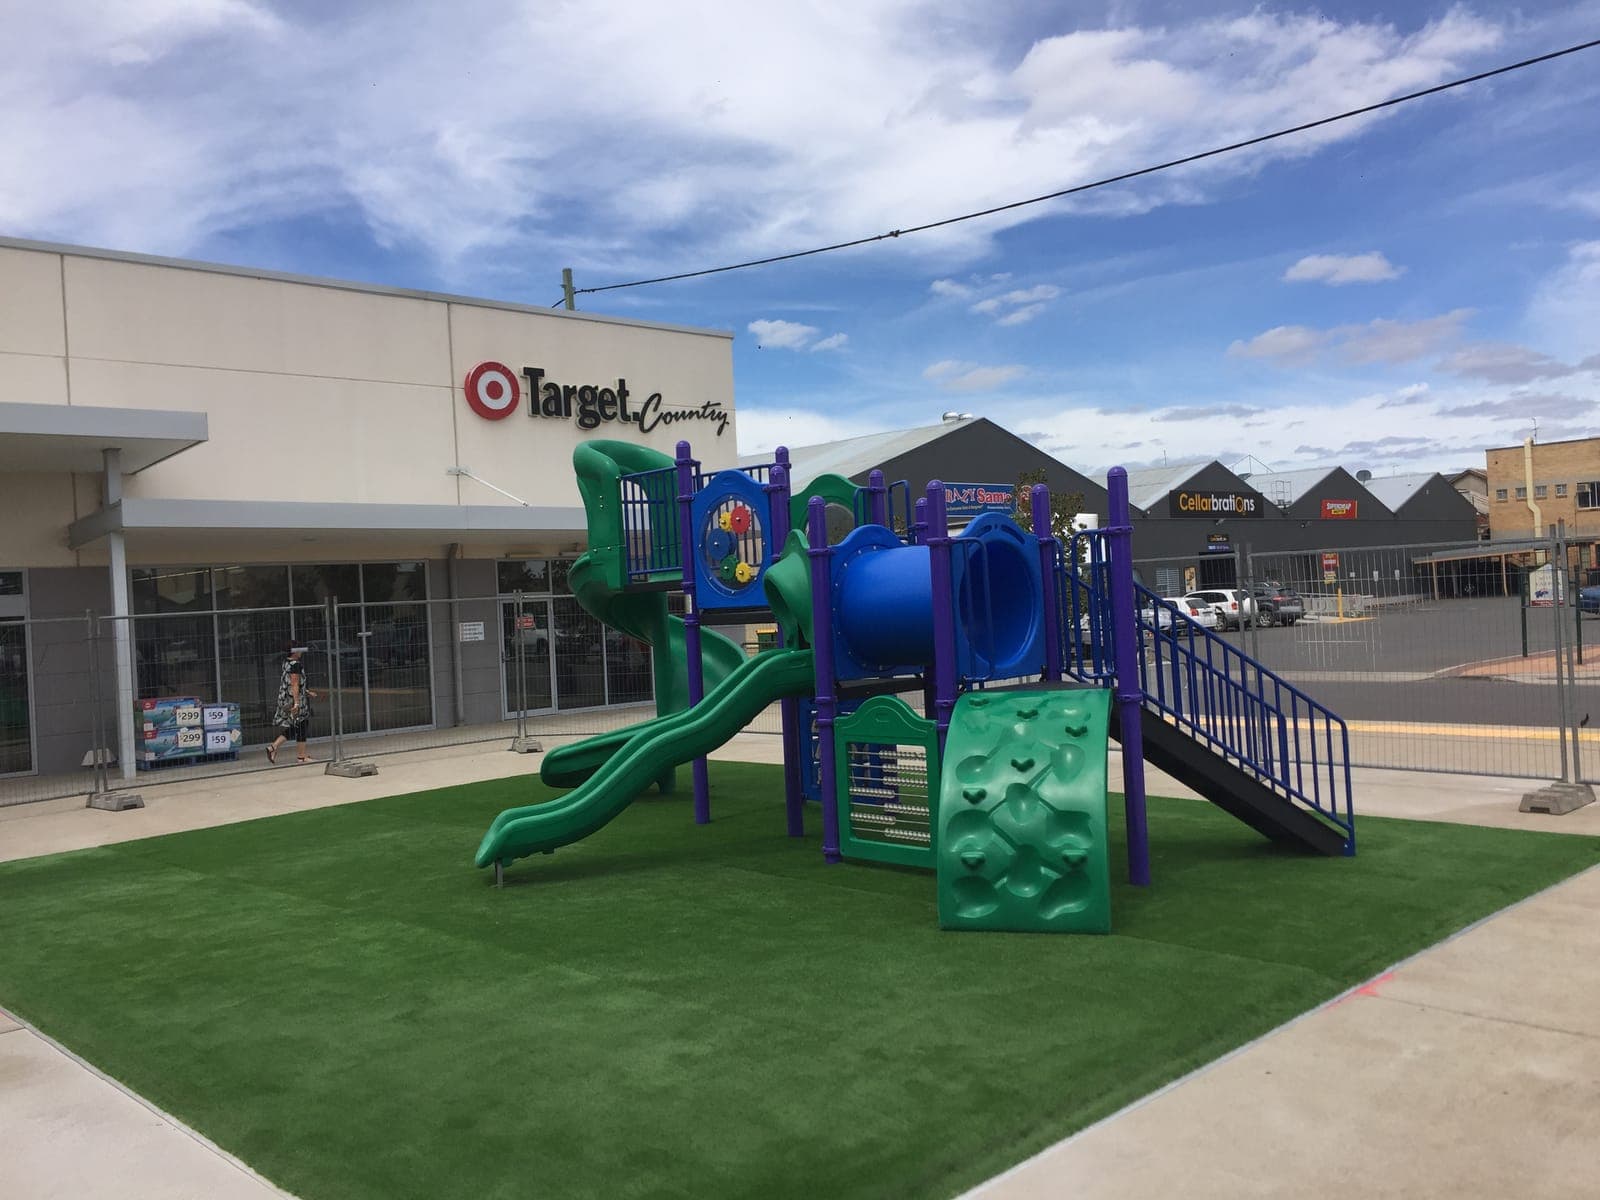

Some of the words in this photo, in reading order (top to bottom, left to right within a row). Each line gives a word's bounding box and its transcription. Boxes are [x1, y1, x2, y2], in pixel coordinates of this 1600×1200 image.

[945, 488, 976, 504] RAZY
[178, 711, 200, 721] $299
[208, 711, 224, 720] $59
[211, 735, 226, 744] $59
